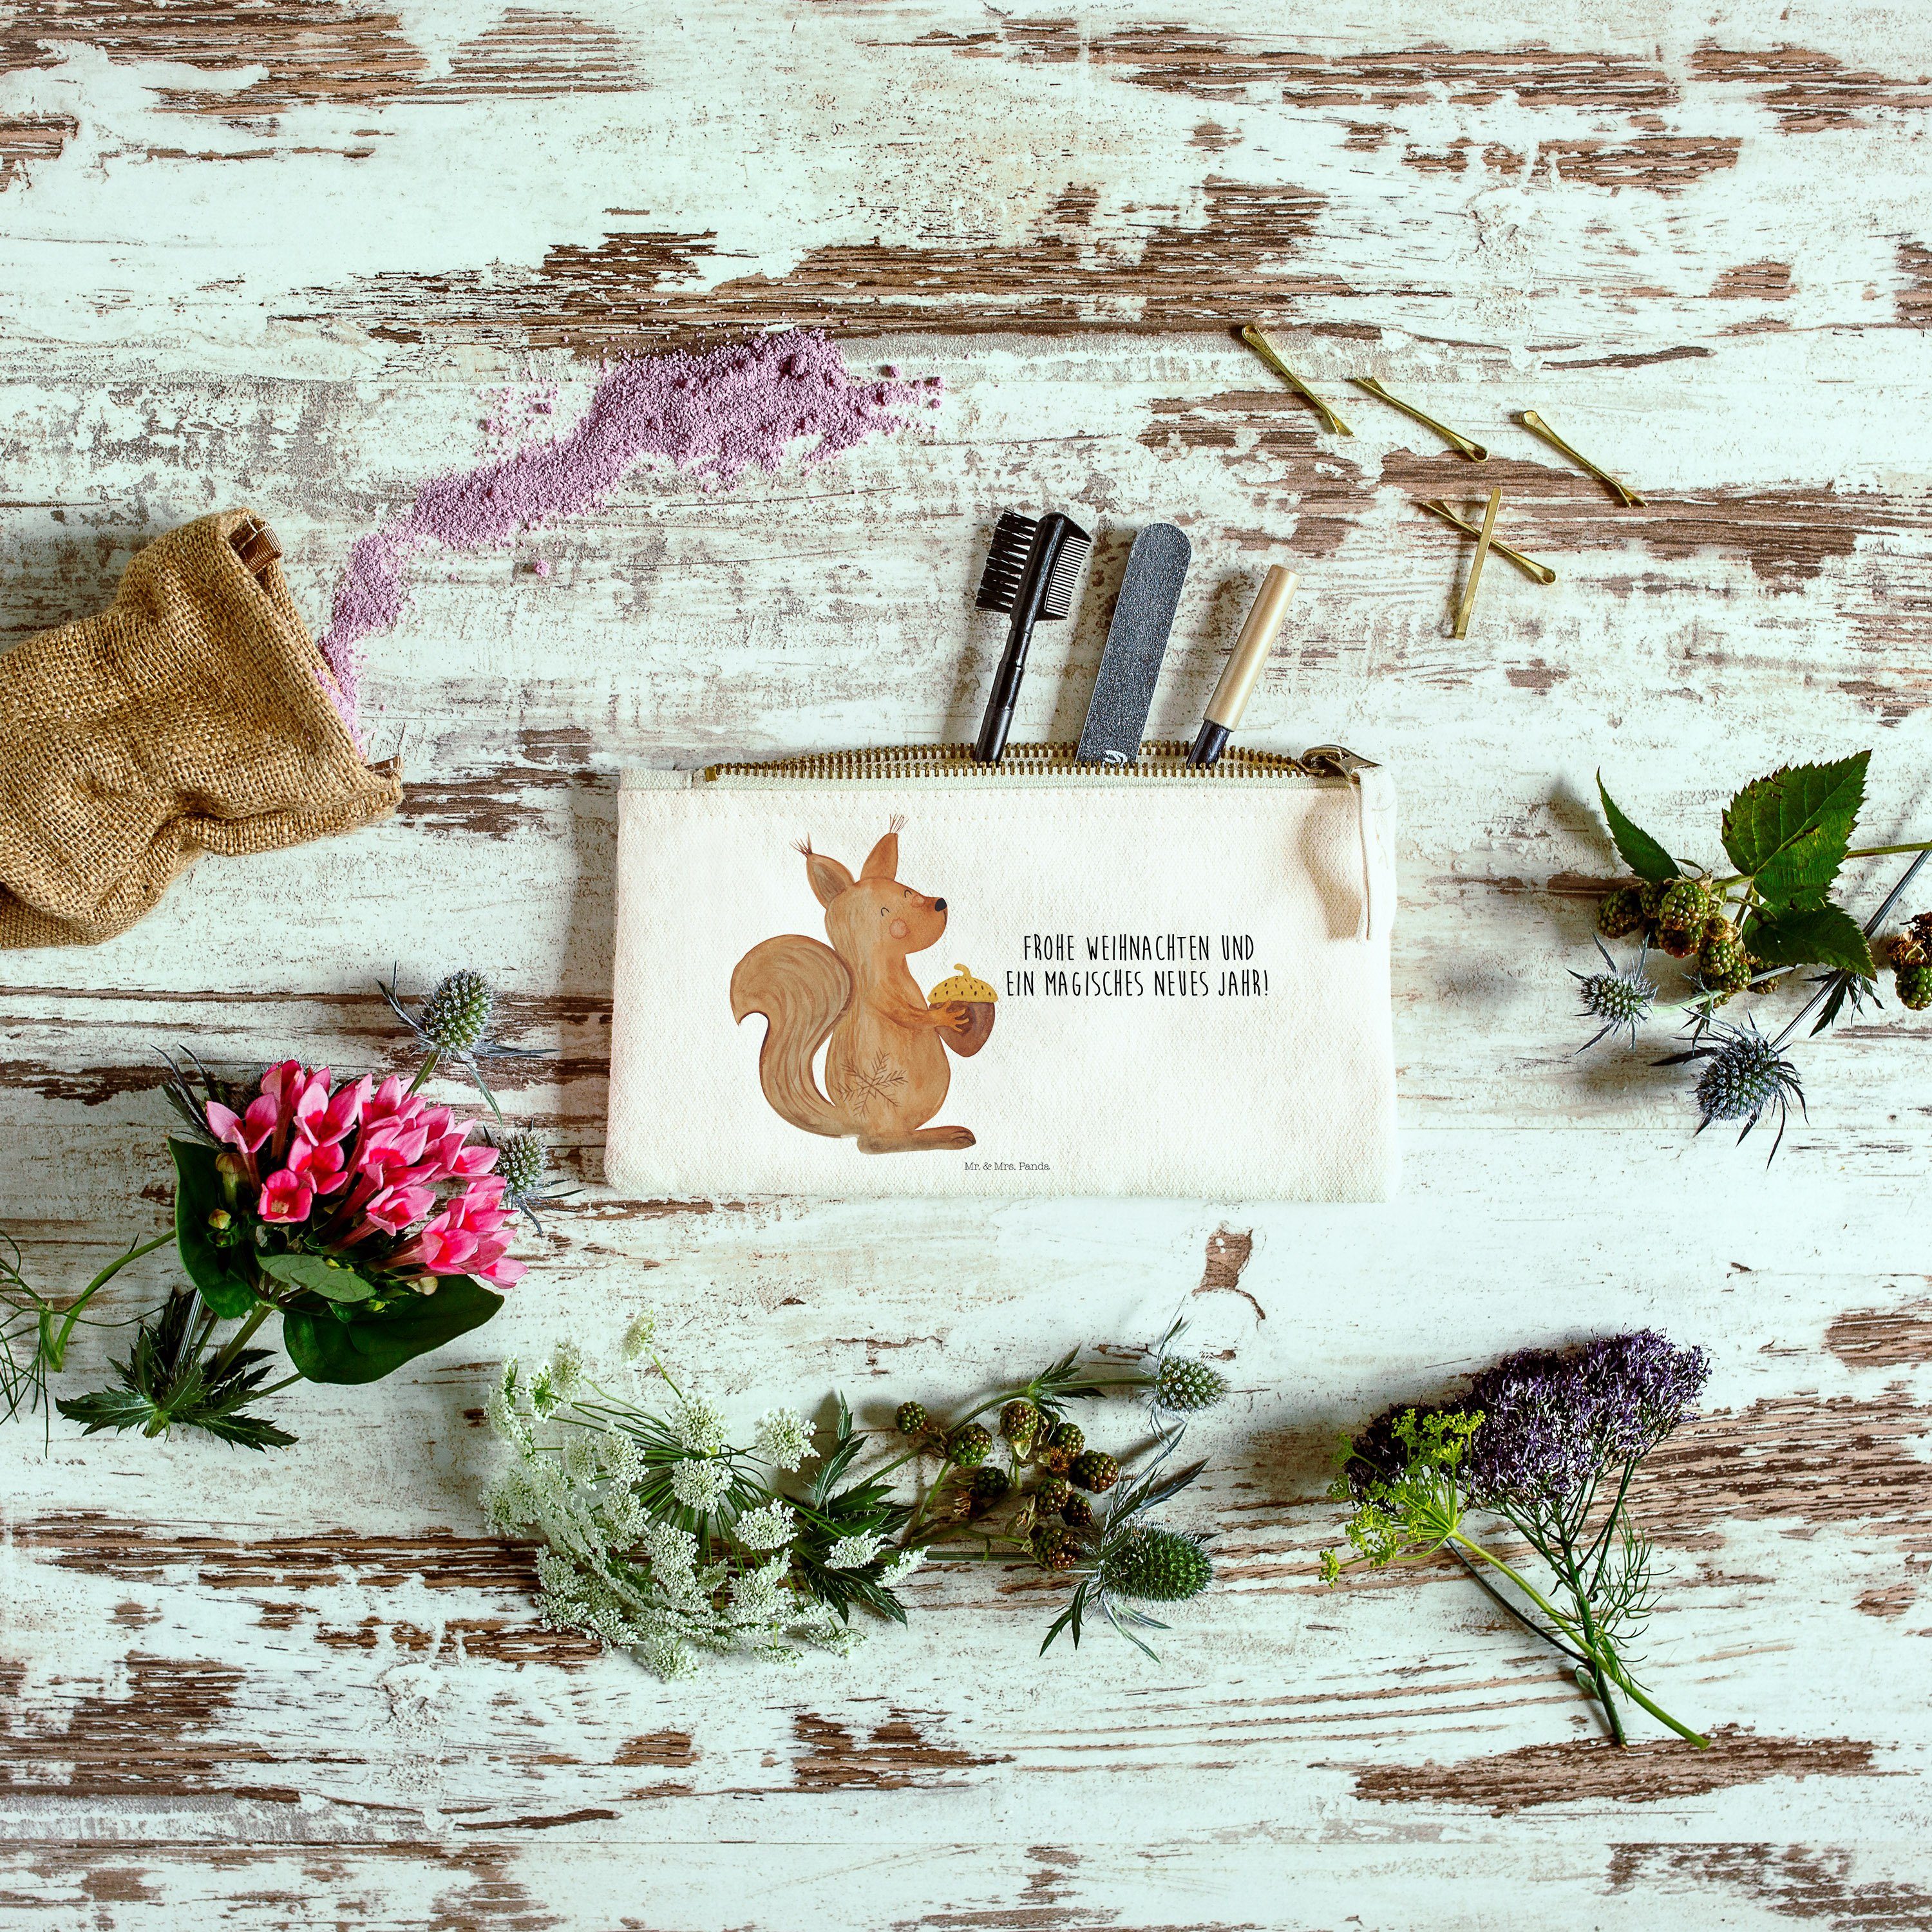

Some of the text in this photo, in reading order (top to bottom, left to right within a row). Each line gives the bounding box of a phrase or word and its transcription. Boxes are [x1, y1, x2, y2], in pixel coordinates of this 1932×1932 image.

[1024, 933, 1255, 961] FROHE WEIHNACHTEN UND
[1007, 969, 1269, 997] EIN MAGISCHES NEUES JAHR!
[964, 1162, 1050, 1171] Mr. & Mrs. Panda
